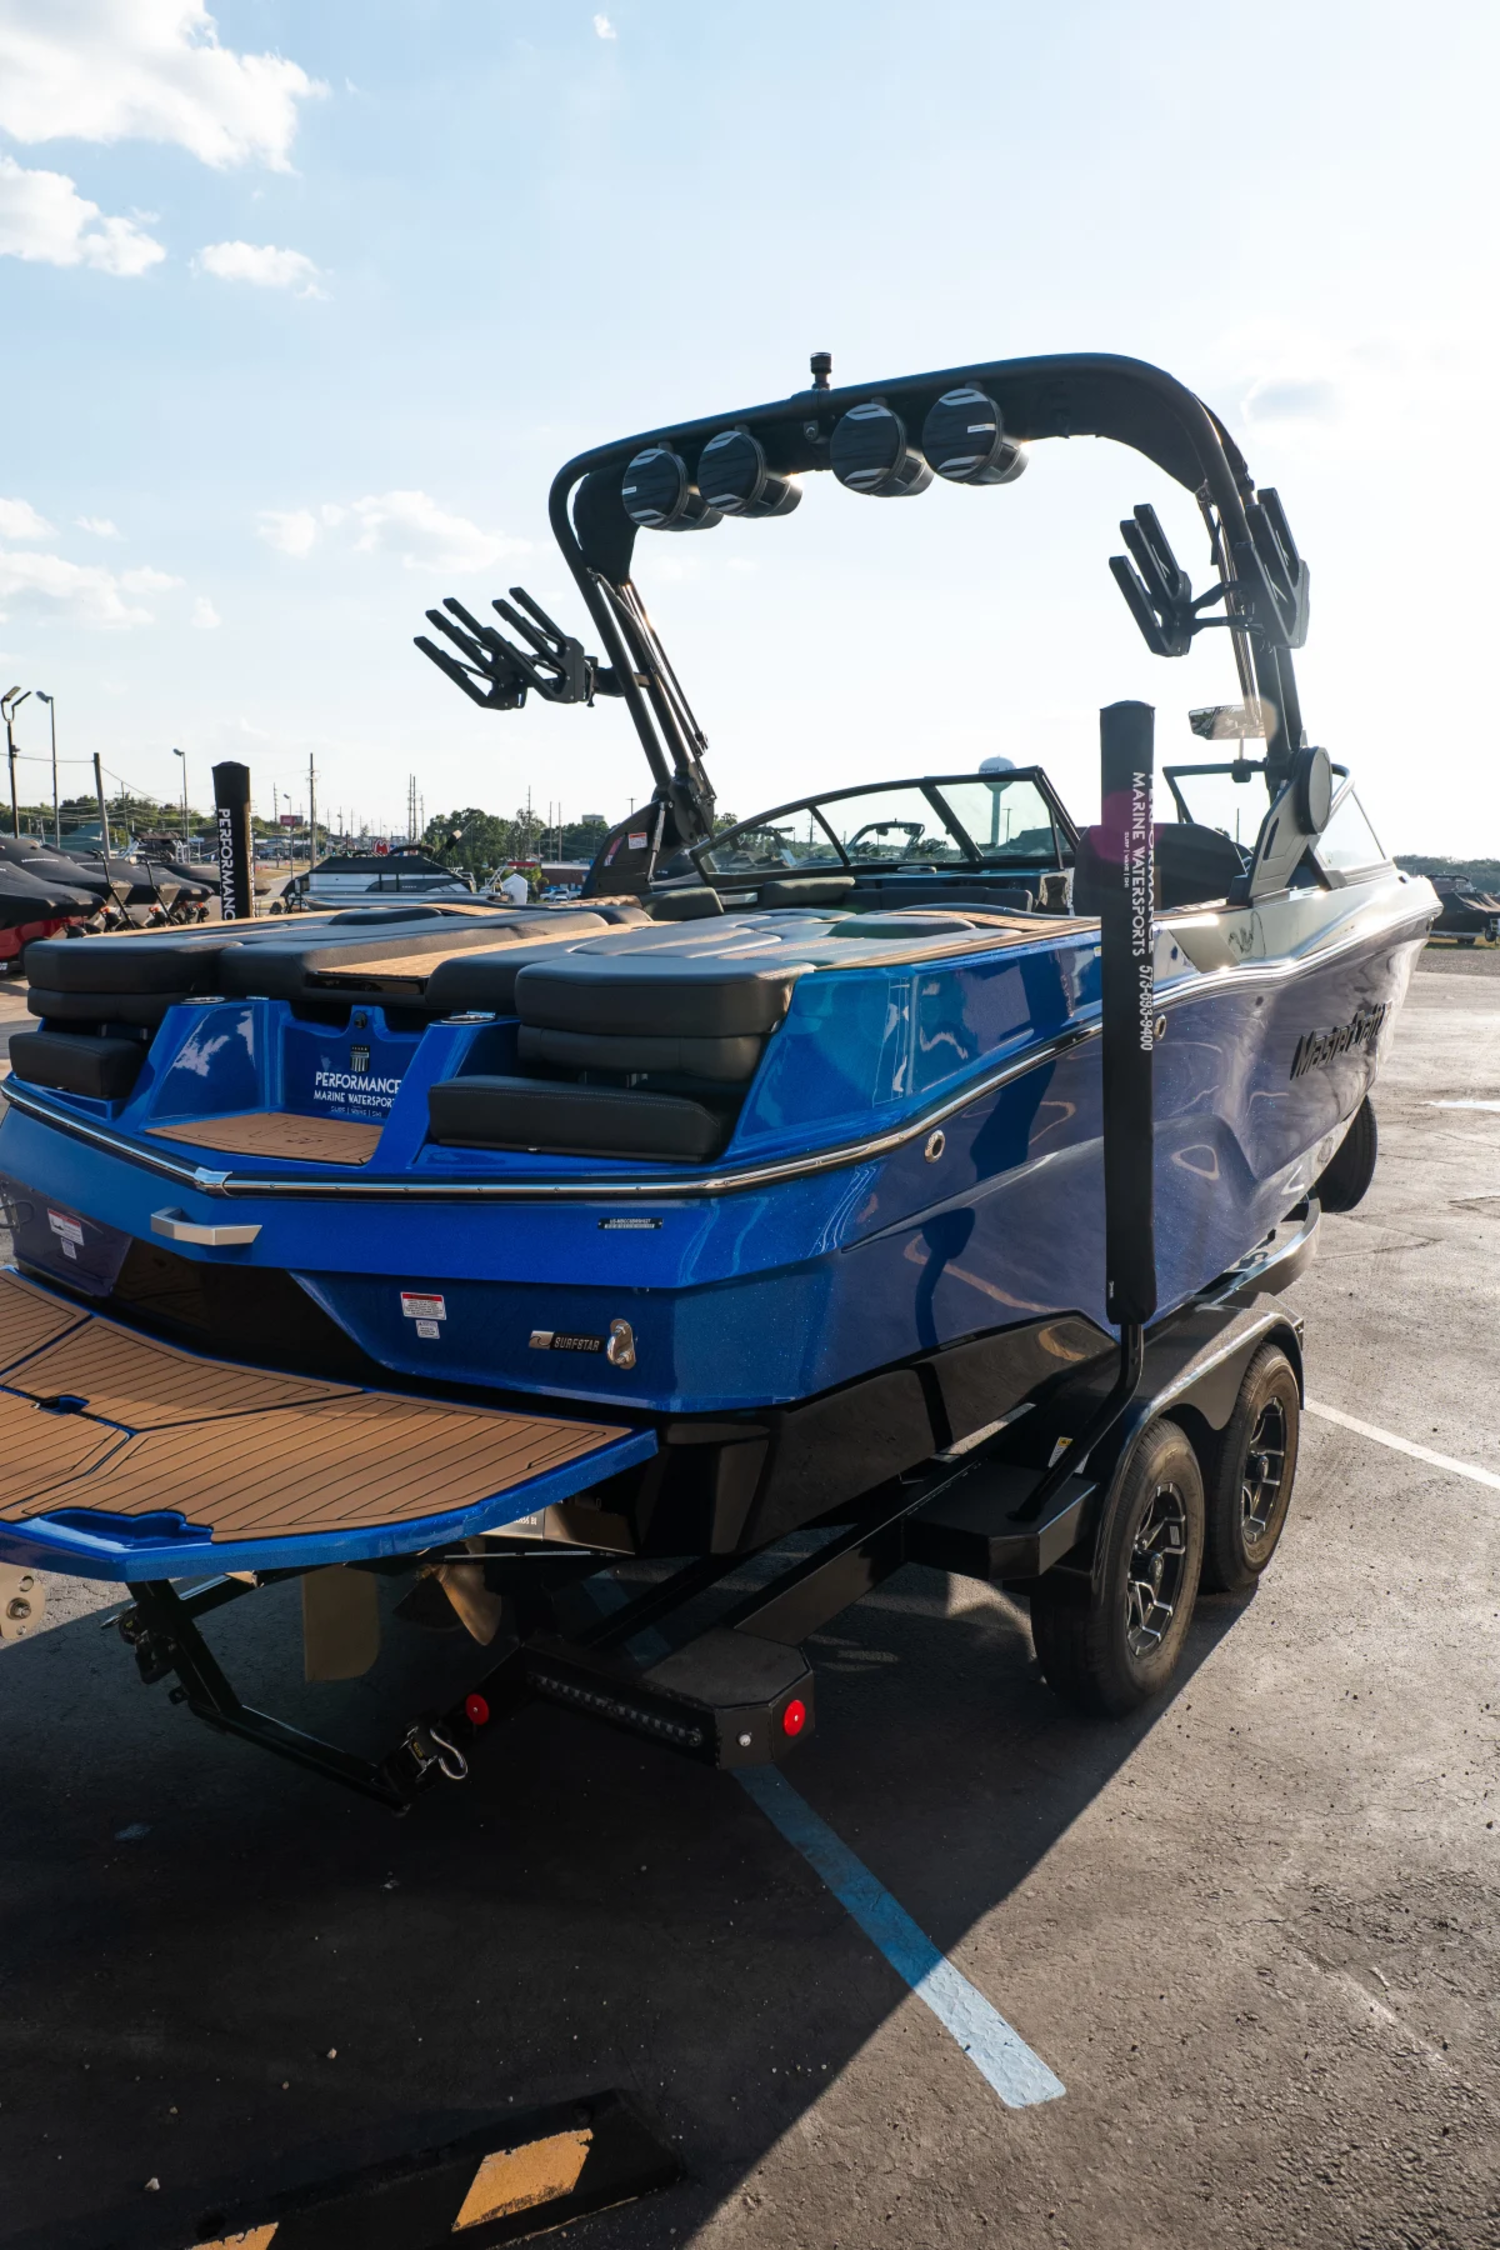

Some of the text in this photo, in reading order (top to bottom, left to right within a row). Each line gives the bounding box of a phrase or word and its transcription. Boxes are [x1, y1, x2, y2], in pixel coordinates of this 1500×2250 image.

[1132, 771, 1154, 1051] MARINE WATERSPORTS 573-693-9400
[313, 1089, 395, 1108] MARINE WATERSPOR
[554, 1336, 601, 1352] SURFSTAR
